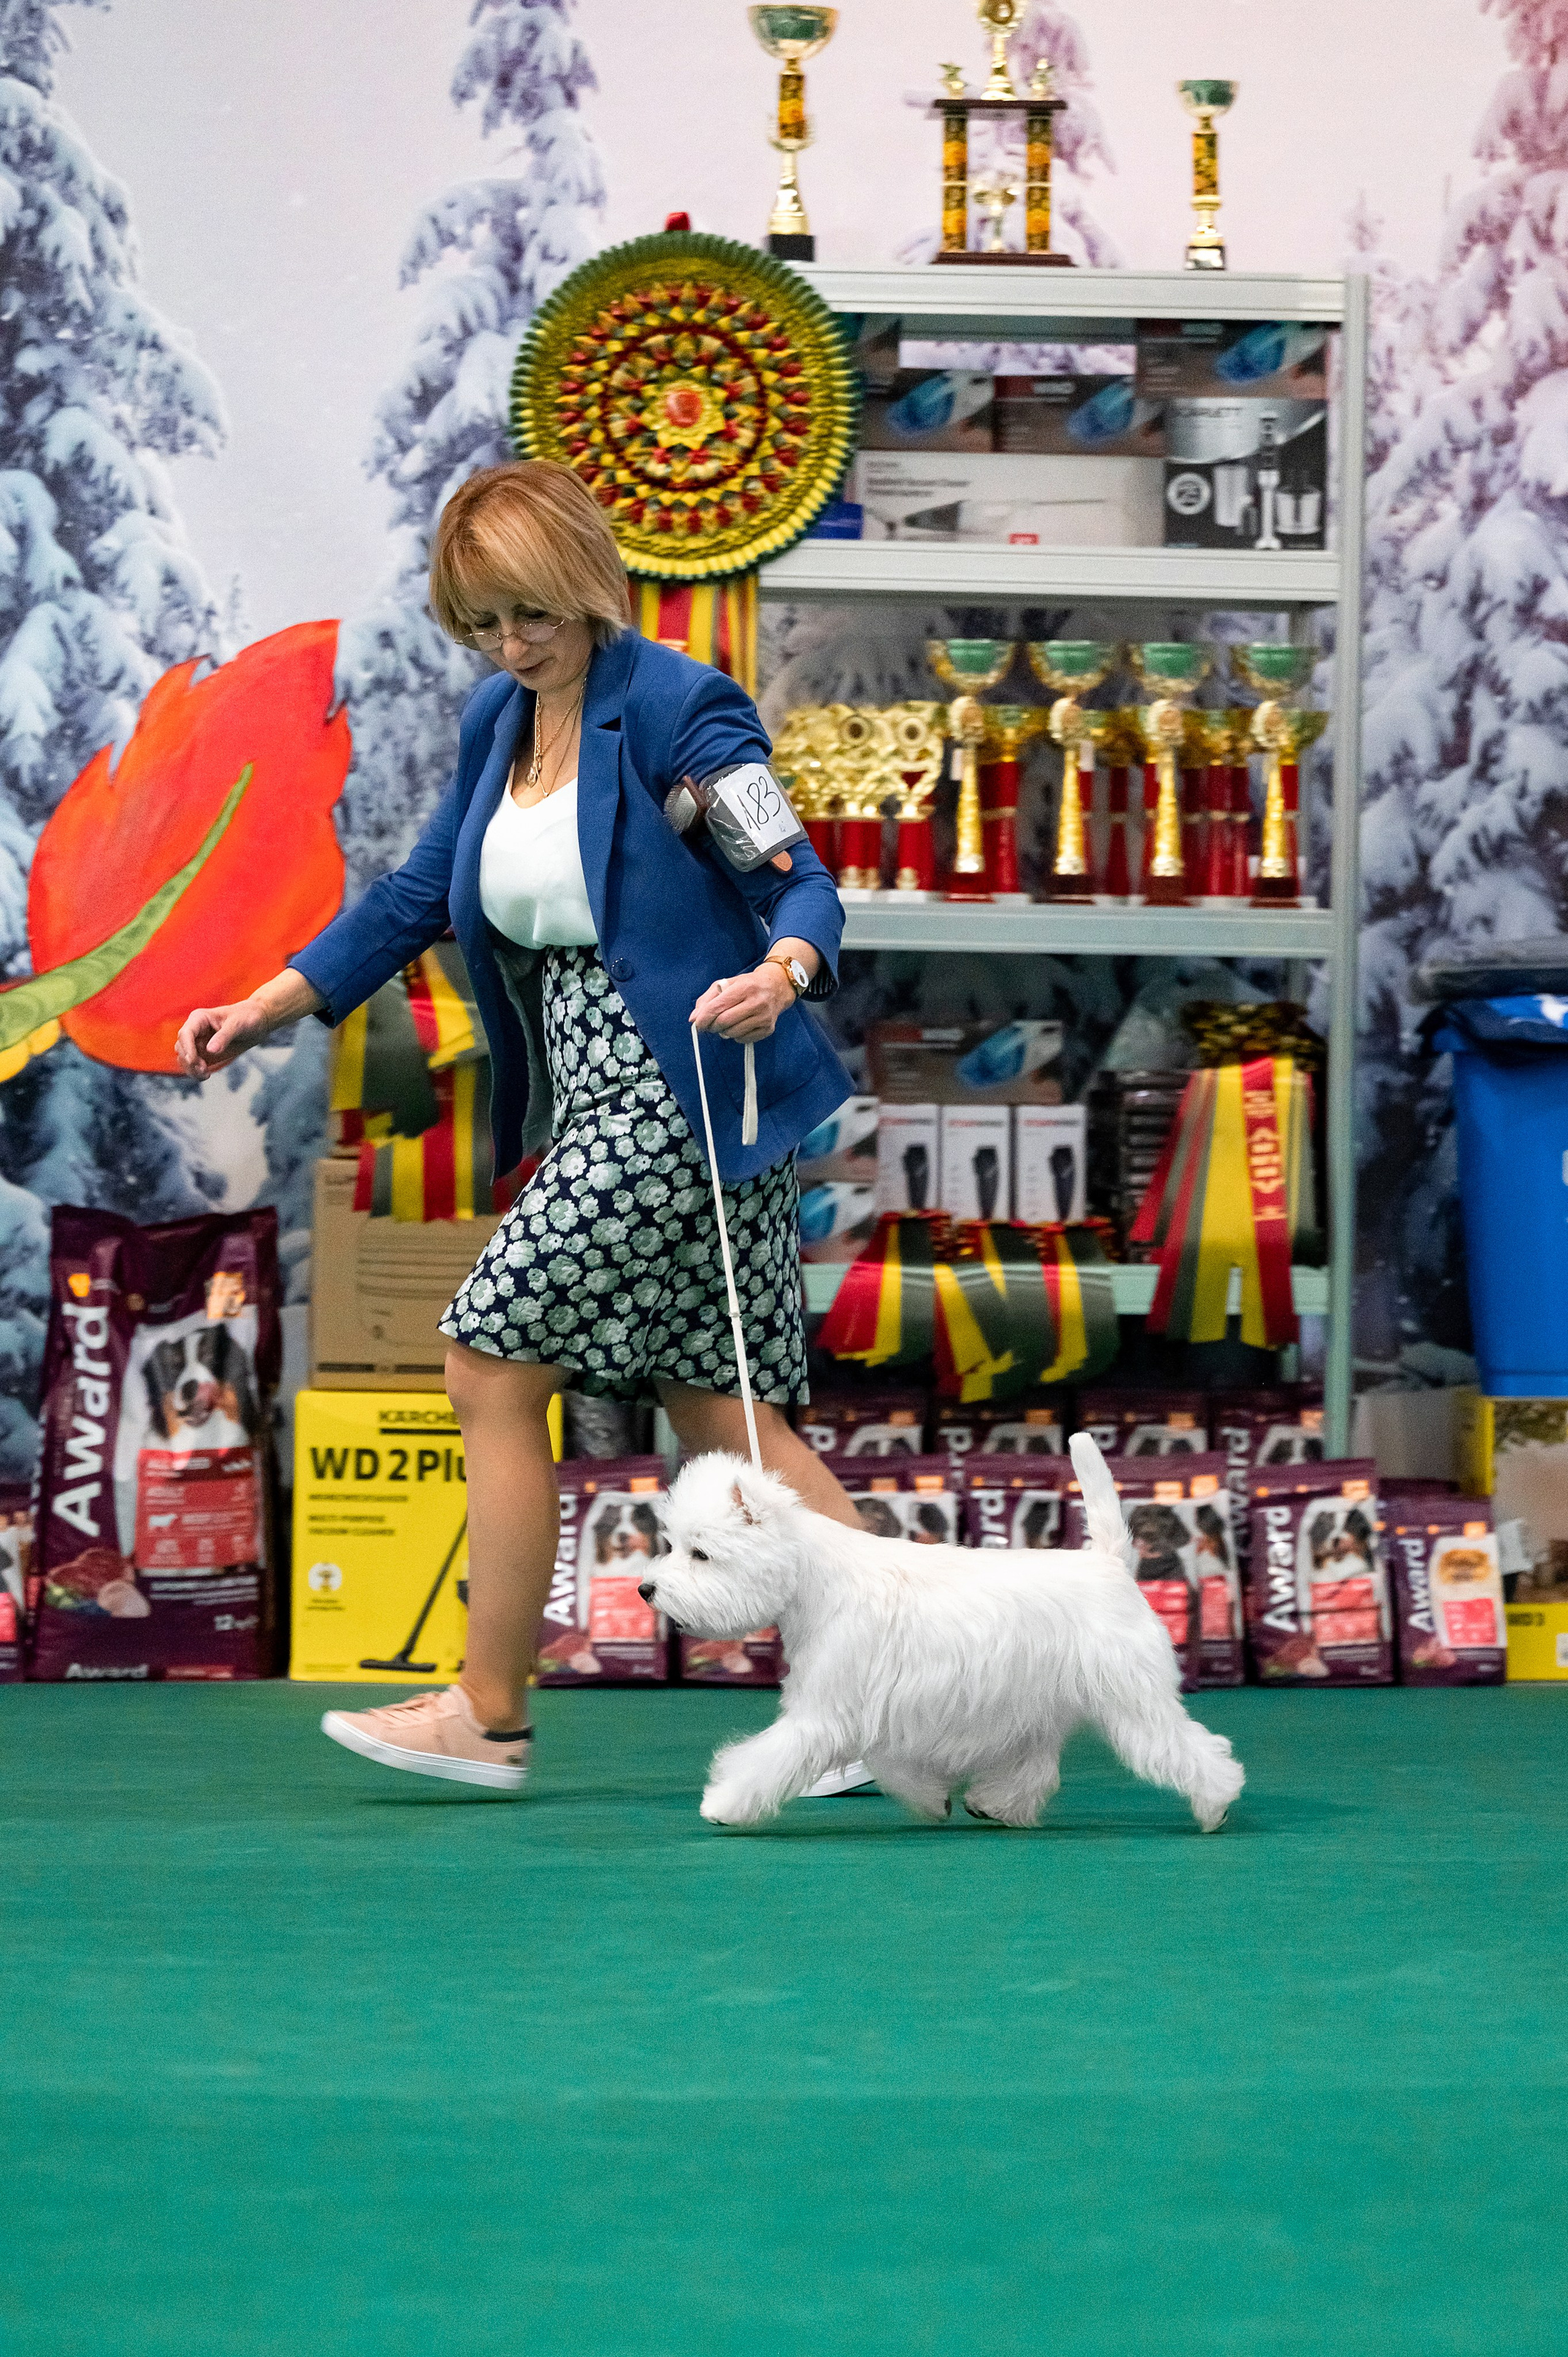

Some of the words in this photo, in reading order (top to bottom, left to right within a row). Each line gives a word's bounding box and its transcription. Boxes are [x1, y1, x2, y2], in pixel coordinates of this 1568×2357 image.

[737, 776, 781, 831] 183
[53, 1303, 111, 1537] Award
[311, 1447, 381, 1480] WD
[388, 1448, 409, 1481] 2
[416, 1449, 467, 1481] Plu
[1257, 1505, 1298, 1633] Award
[1398, 1538, 1436, 1632] Award
[66, 1663, 149, 1679] Award
